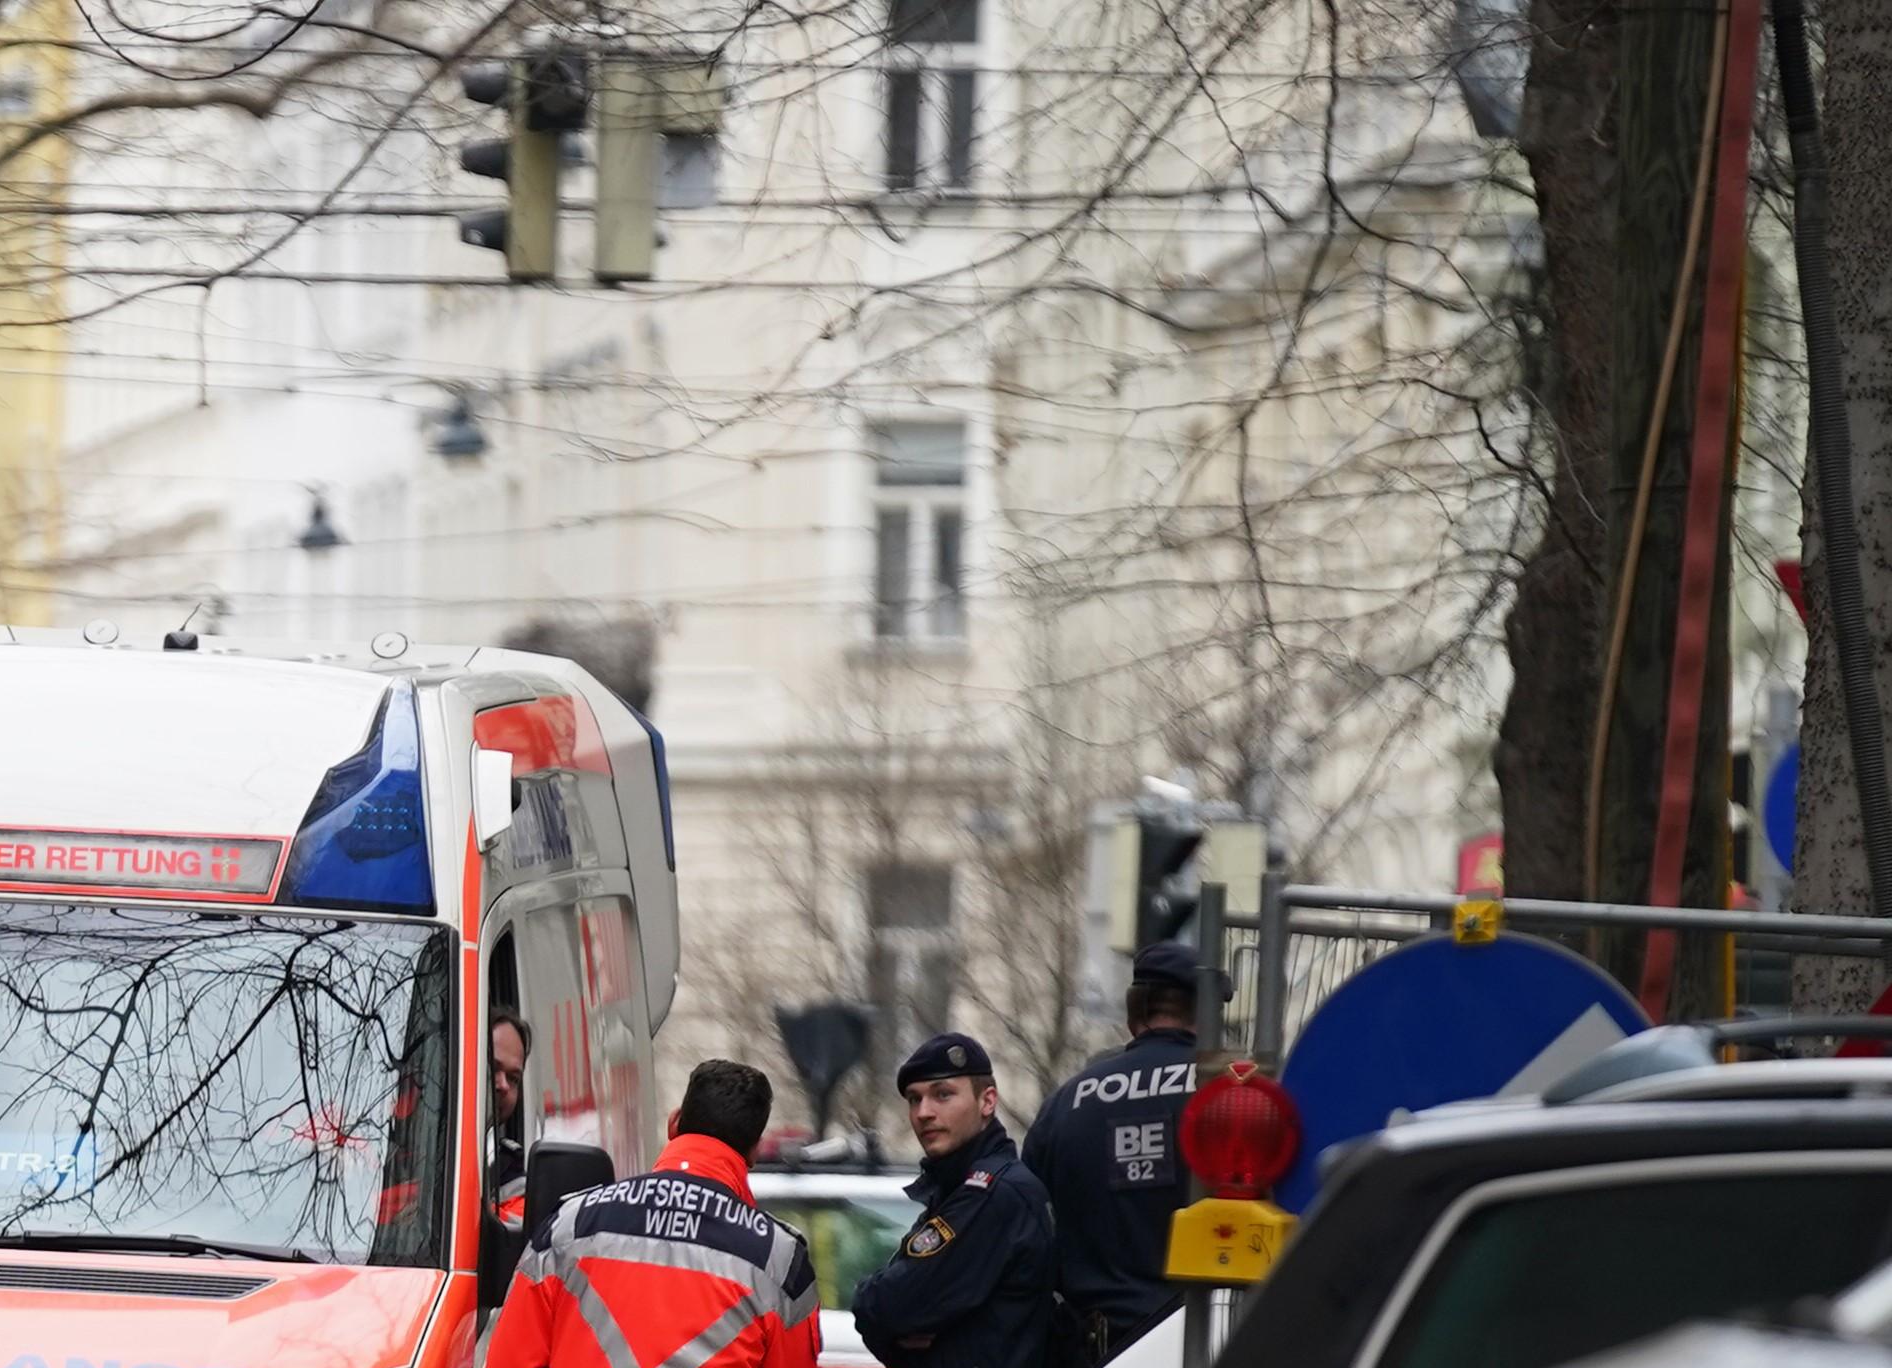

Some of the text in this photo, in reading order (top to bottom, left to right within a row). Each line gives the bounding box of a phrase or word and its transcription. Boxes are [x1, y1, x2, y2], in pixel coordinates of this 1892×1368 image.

[45, 845, 202, 876] RETTUNG
[1072, 1063, 1197, 1110] POLIZ
[1115, 1122, 1165, 1157] BE
[1127, 1160, 1155, 1181] 82
[584, 1178, 769, 1236] BERUFSRETTUNG
[645, 1208, 701, 1239] WIEN
